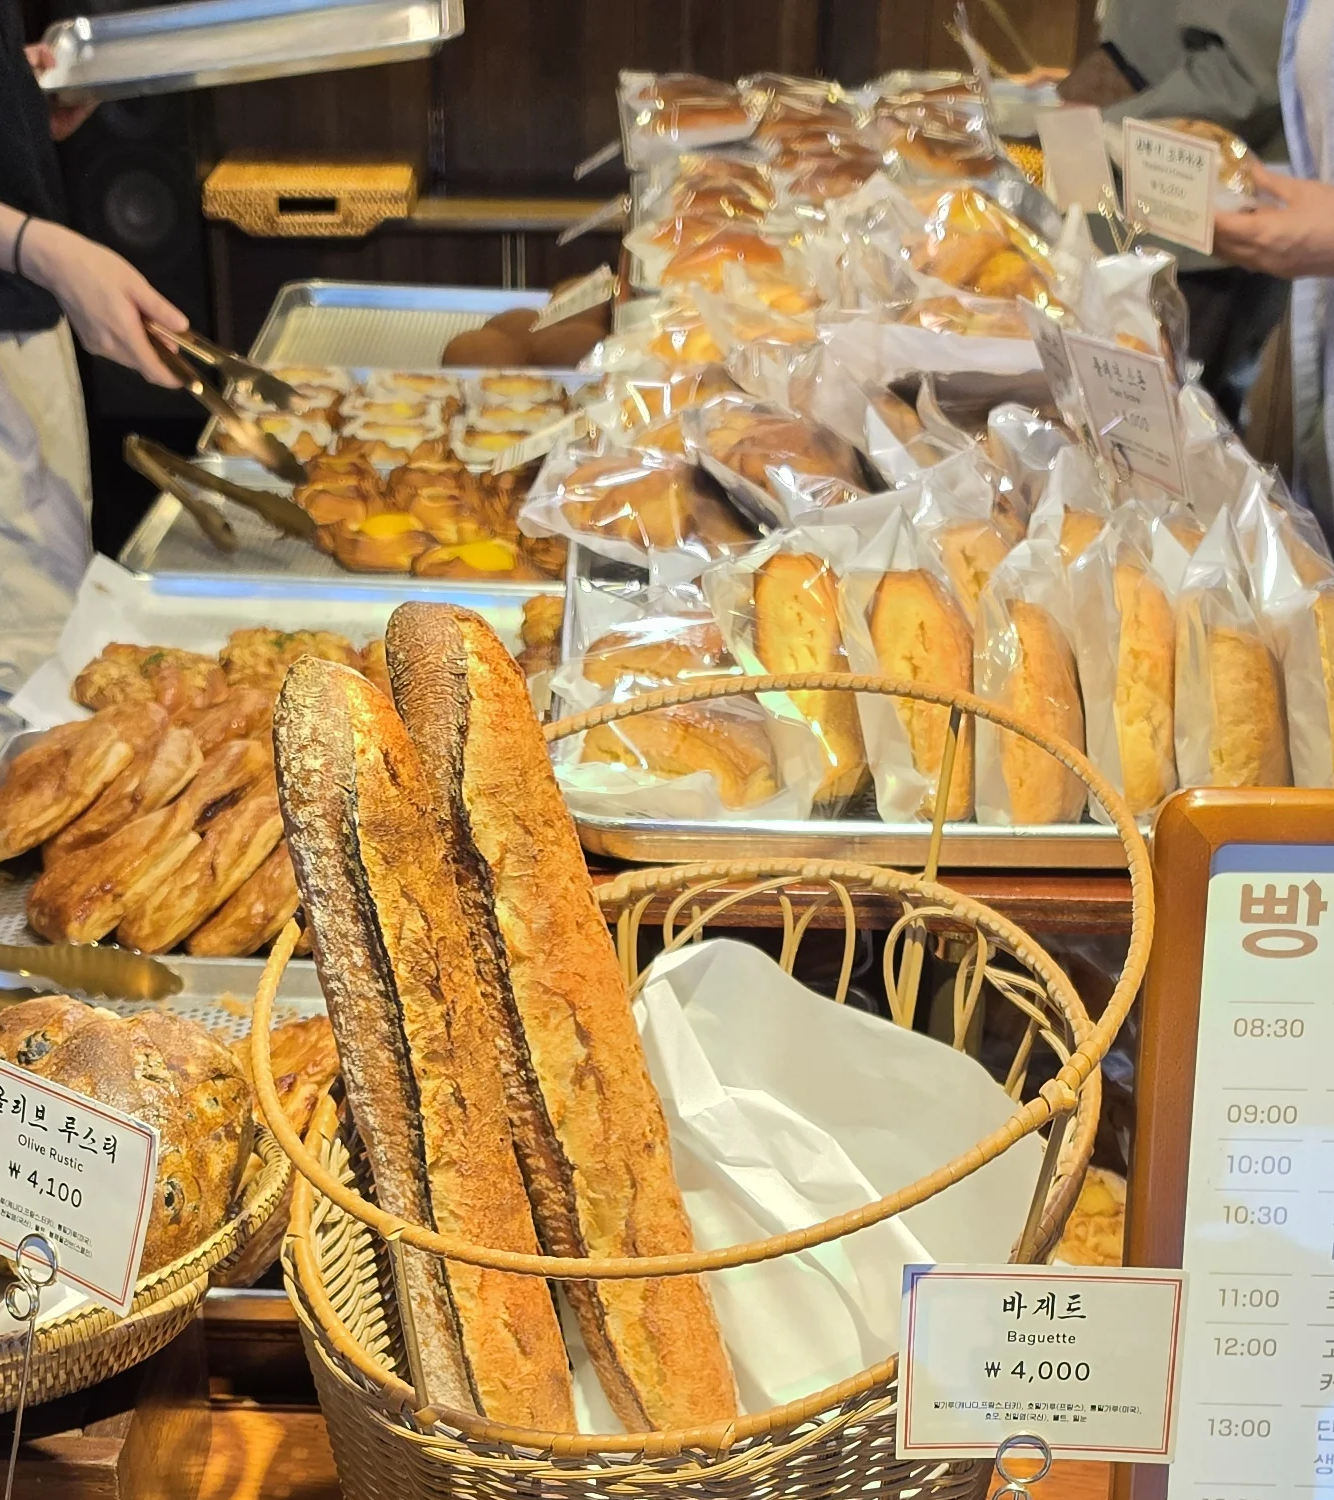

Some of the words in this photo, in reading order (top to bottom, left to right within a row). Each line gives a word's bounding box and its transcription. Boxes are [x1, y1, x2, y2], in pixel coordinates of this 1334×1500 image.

[1239, 879, 1328, 960] 빵
[1233, 1018, 1304, 1038] 08:30
[1227, 1104, 1298, 1124] 09:00
[58, 1116, 118, 1164] 루스틱
[18, 1134, 45, 1156] Olive
[50, 1147, 84, 1173] Rustic
[1226, 1155, 1292, 1175] 10:00
[27, 1170, 83, 1208] 4,100
[1223, 1205, 1288, 1225] 10:30
[1002, 1291, 1087, 1321] 바게트
[1219, 1288, 1280, 1308] 11:00
[1007, 1330, 1077, 1345] Baguette
[1214, 1337, 1277, 1357] 12:00
[1010, 1360, 1091, 1384] 4,000
[1207, 1418, 1271, 1438] 13:00
